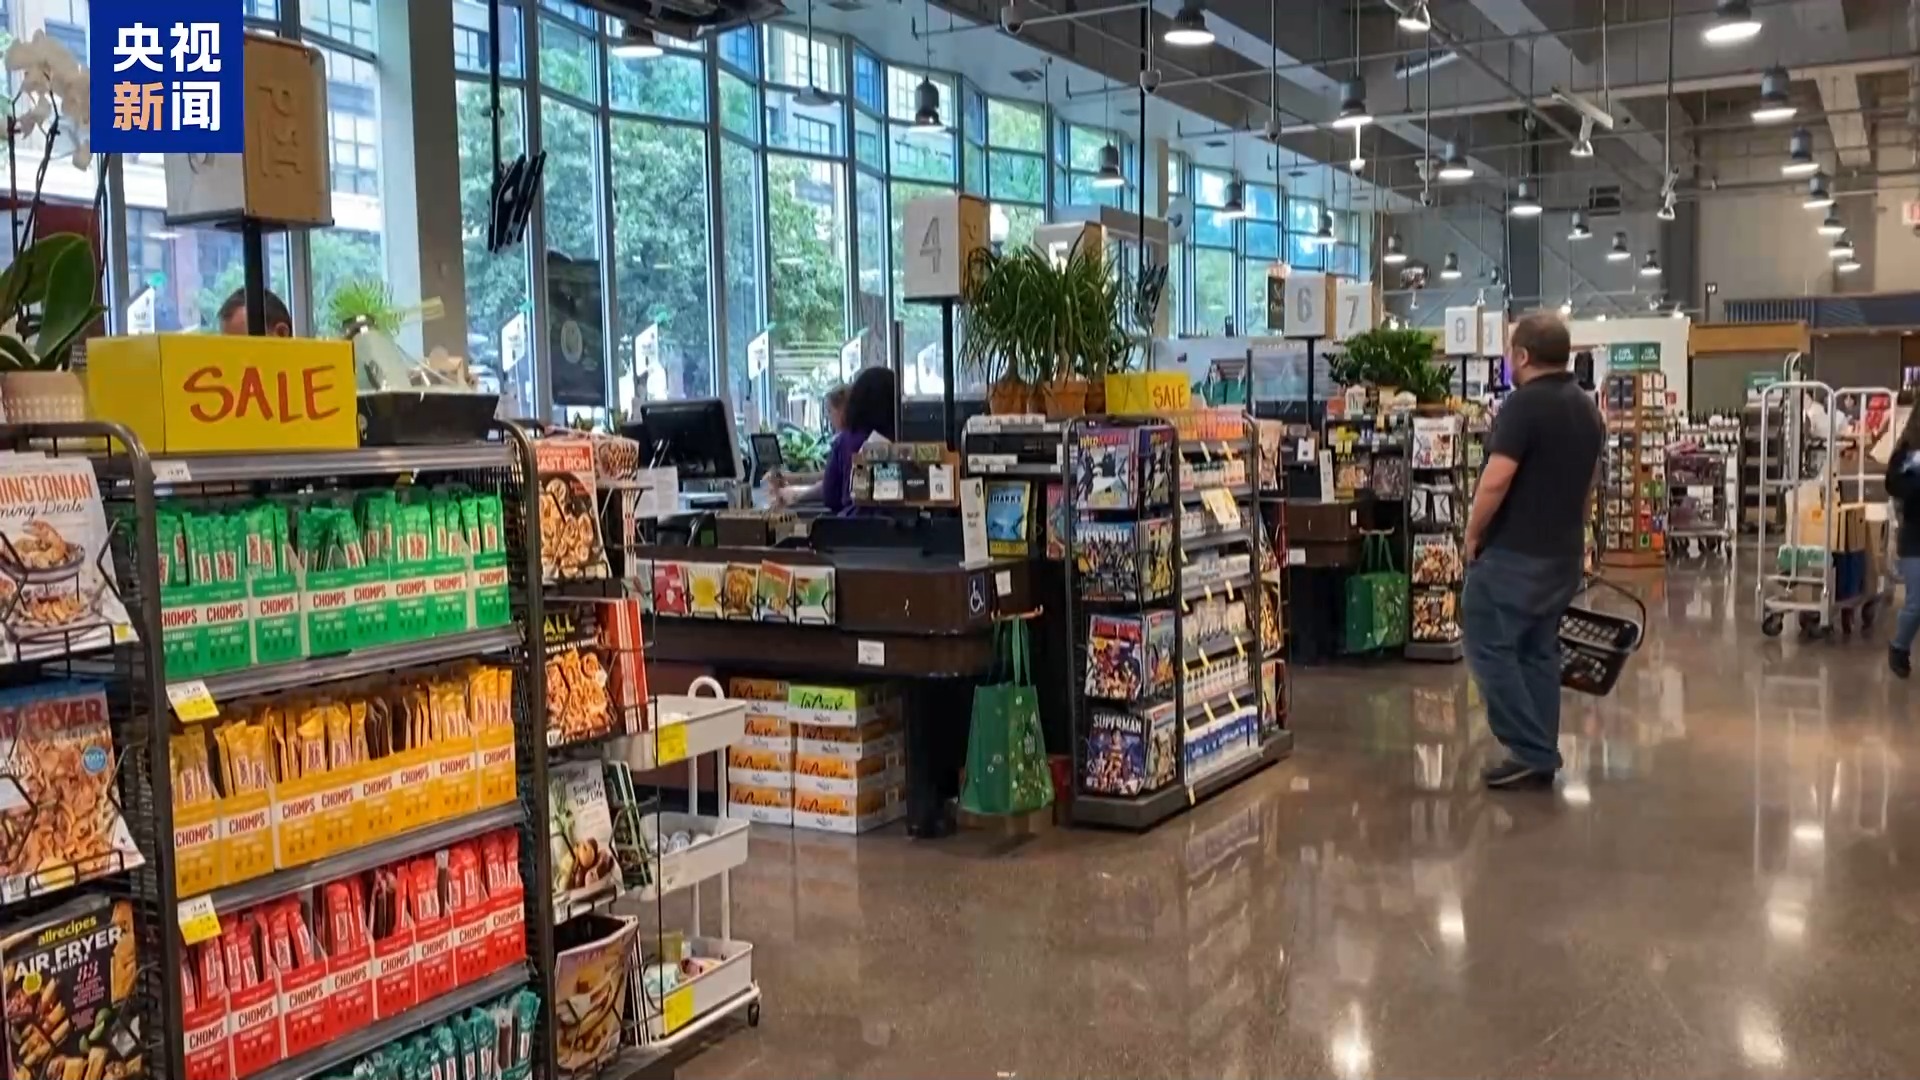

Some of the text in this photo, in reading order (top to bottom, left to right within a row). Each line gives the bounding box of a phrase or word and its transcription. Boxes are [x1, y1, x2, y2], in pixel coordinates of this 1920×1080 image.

[920, 216, 942, 273] 4
[1297, 287, 1313, 324] 6
[1345, 295, 1360, 329] 7
[1455, 317, 1466, 343] 8
[183, 365, 340, 424] SALE
[1152, 384, 1185, 409] SALE
[563, 456, 590, 471] IRON
[41, 496, 84, 515] Deals
[479, 569, 505, 585] CHOMPS
[313, 576, 462, 609] CHOMPS CHOMPS CHOMPS CHOMPS
[206, 602, 244, 623] CHOMPS
[260, 597, 294, 616] CHOMPS
[544, 614, 575, 636] ALL
[1092, 714, 1142, 734] SUPERMAN
[439, 757, 471, 776] CHOMPS
[483, 747, 511, 766] CHOMPS
[282, 765, 430, 819] CHOMPS CHOMPS CHOMPS CHOMPS
[229, 812, 265, 834] CHOMPS
[175, 823, 214, 849] CHOMPS
[493, 906, 521, 927] CHOMPS
[38, 916, 97, 947] allrecipes
[459, 922, 487, 943] CHOMPS
[14, 927, 122, 982] AIR FRYER
[421, 935, 449, 957] CHOMPS
[380, 953, 410, 973] CHOMPS
[334, 966, 367, 990] CHOMPS
[289, 984, 324, 1008] CHOMPS
[238, 1003, 273, 1028] CHOMPS
[189, 1021, 224, 1050] CHOMPS
